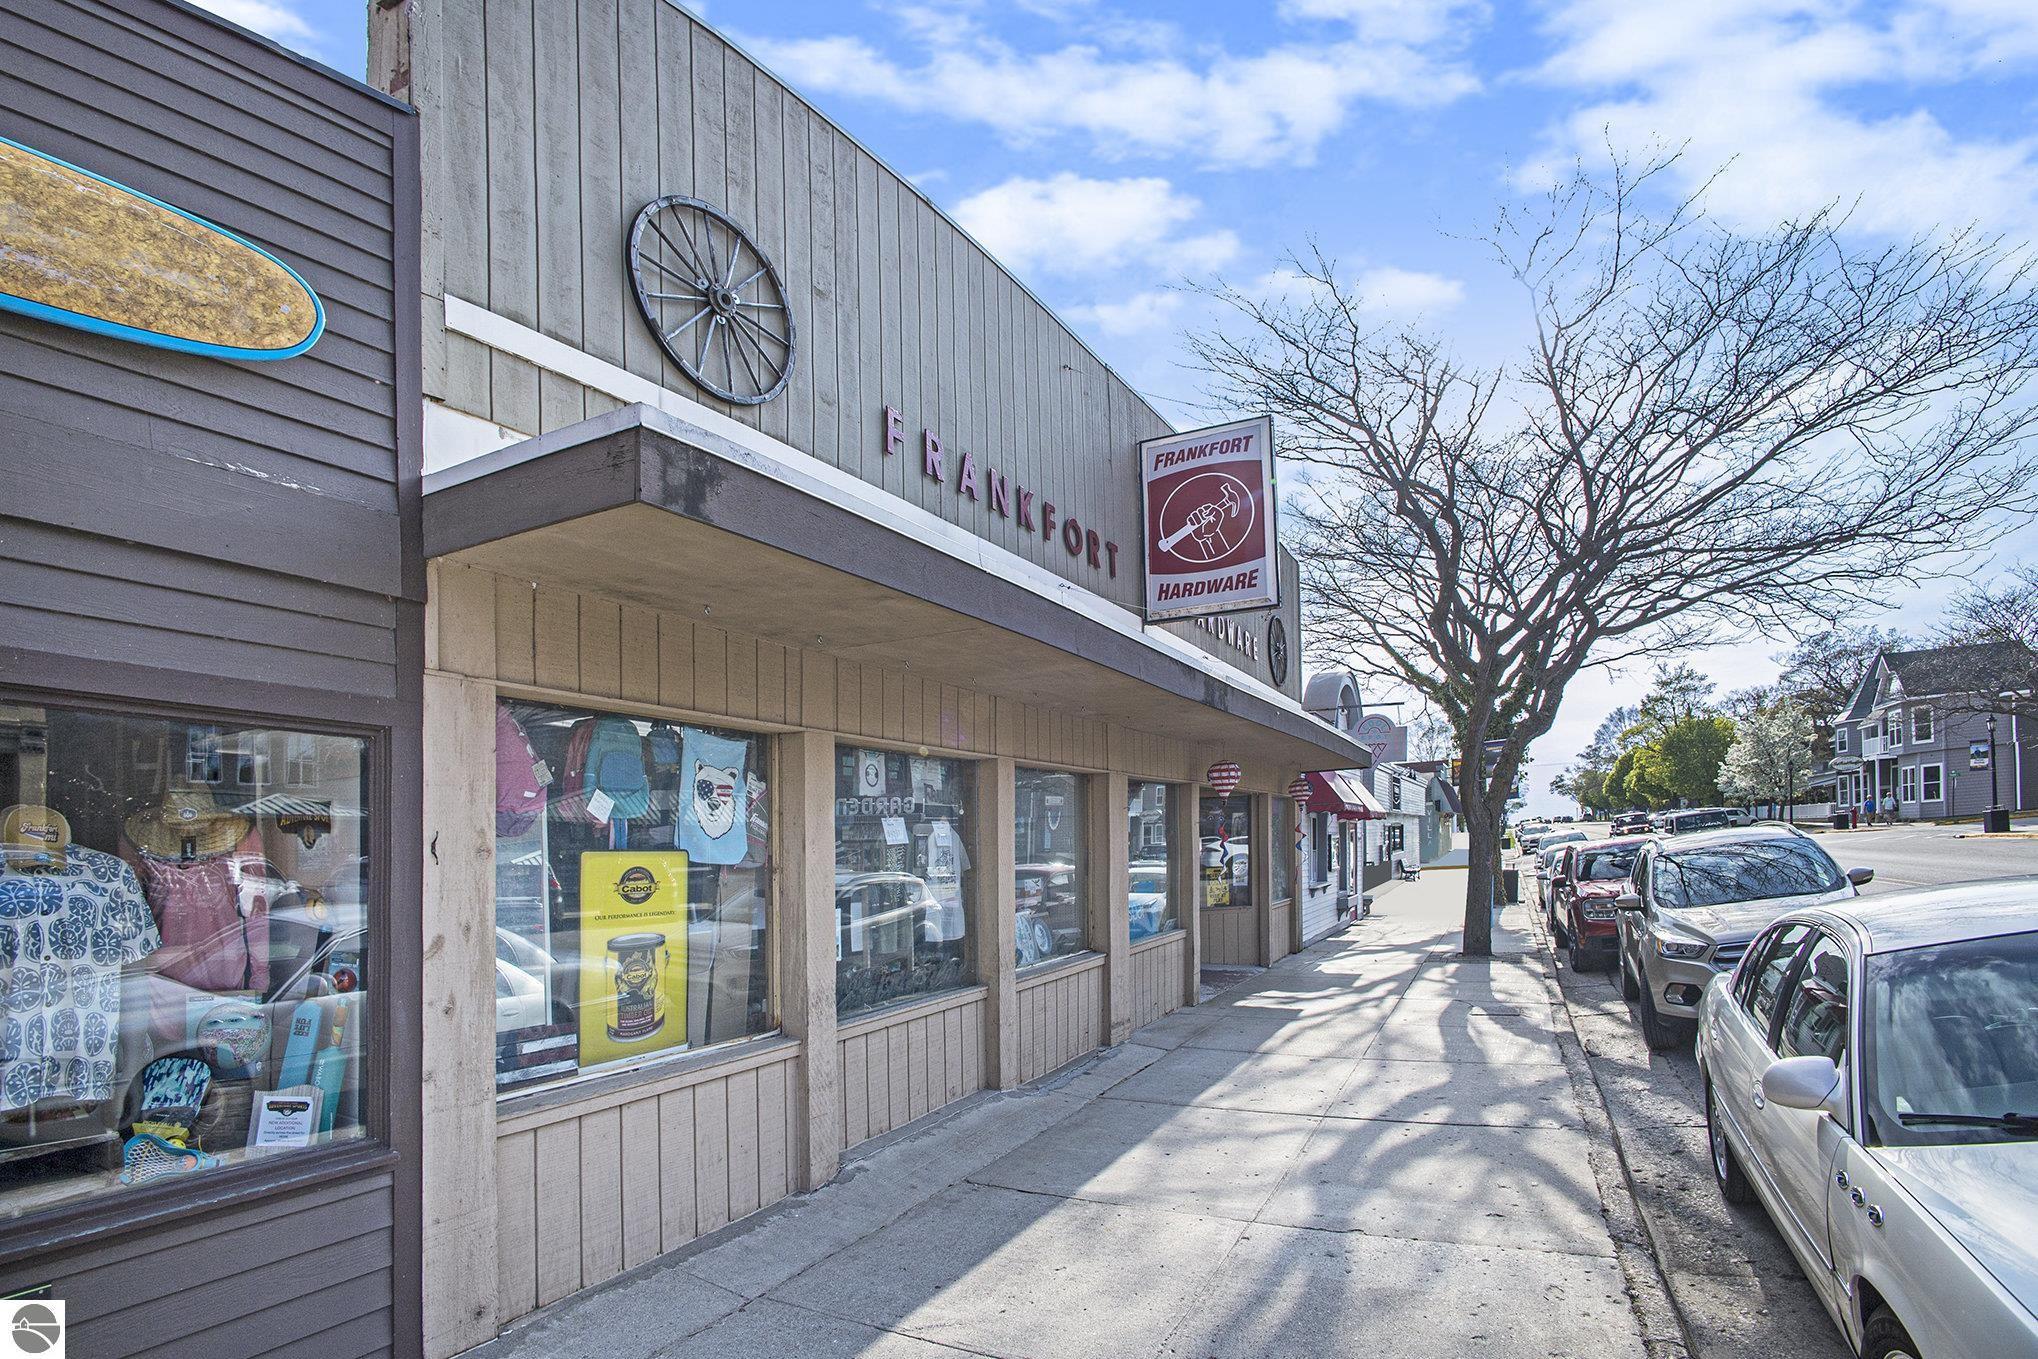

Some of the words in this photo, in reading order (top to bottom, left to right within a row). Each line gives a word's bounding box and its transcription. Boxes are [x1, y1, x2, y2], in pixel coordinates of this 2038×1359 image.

[1153, 434, 1254, 472] FRANKFORT
[884, 405, 1120, 578] FRANKFORT
[1156, 568, 1259, 602] HARDWARE
[621, 885, 652, 893] Cabot
[608, 912, 643, 920] PERFORMANCE
[626, 972, 647, 980] Cabot
